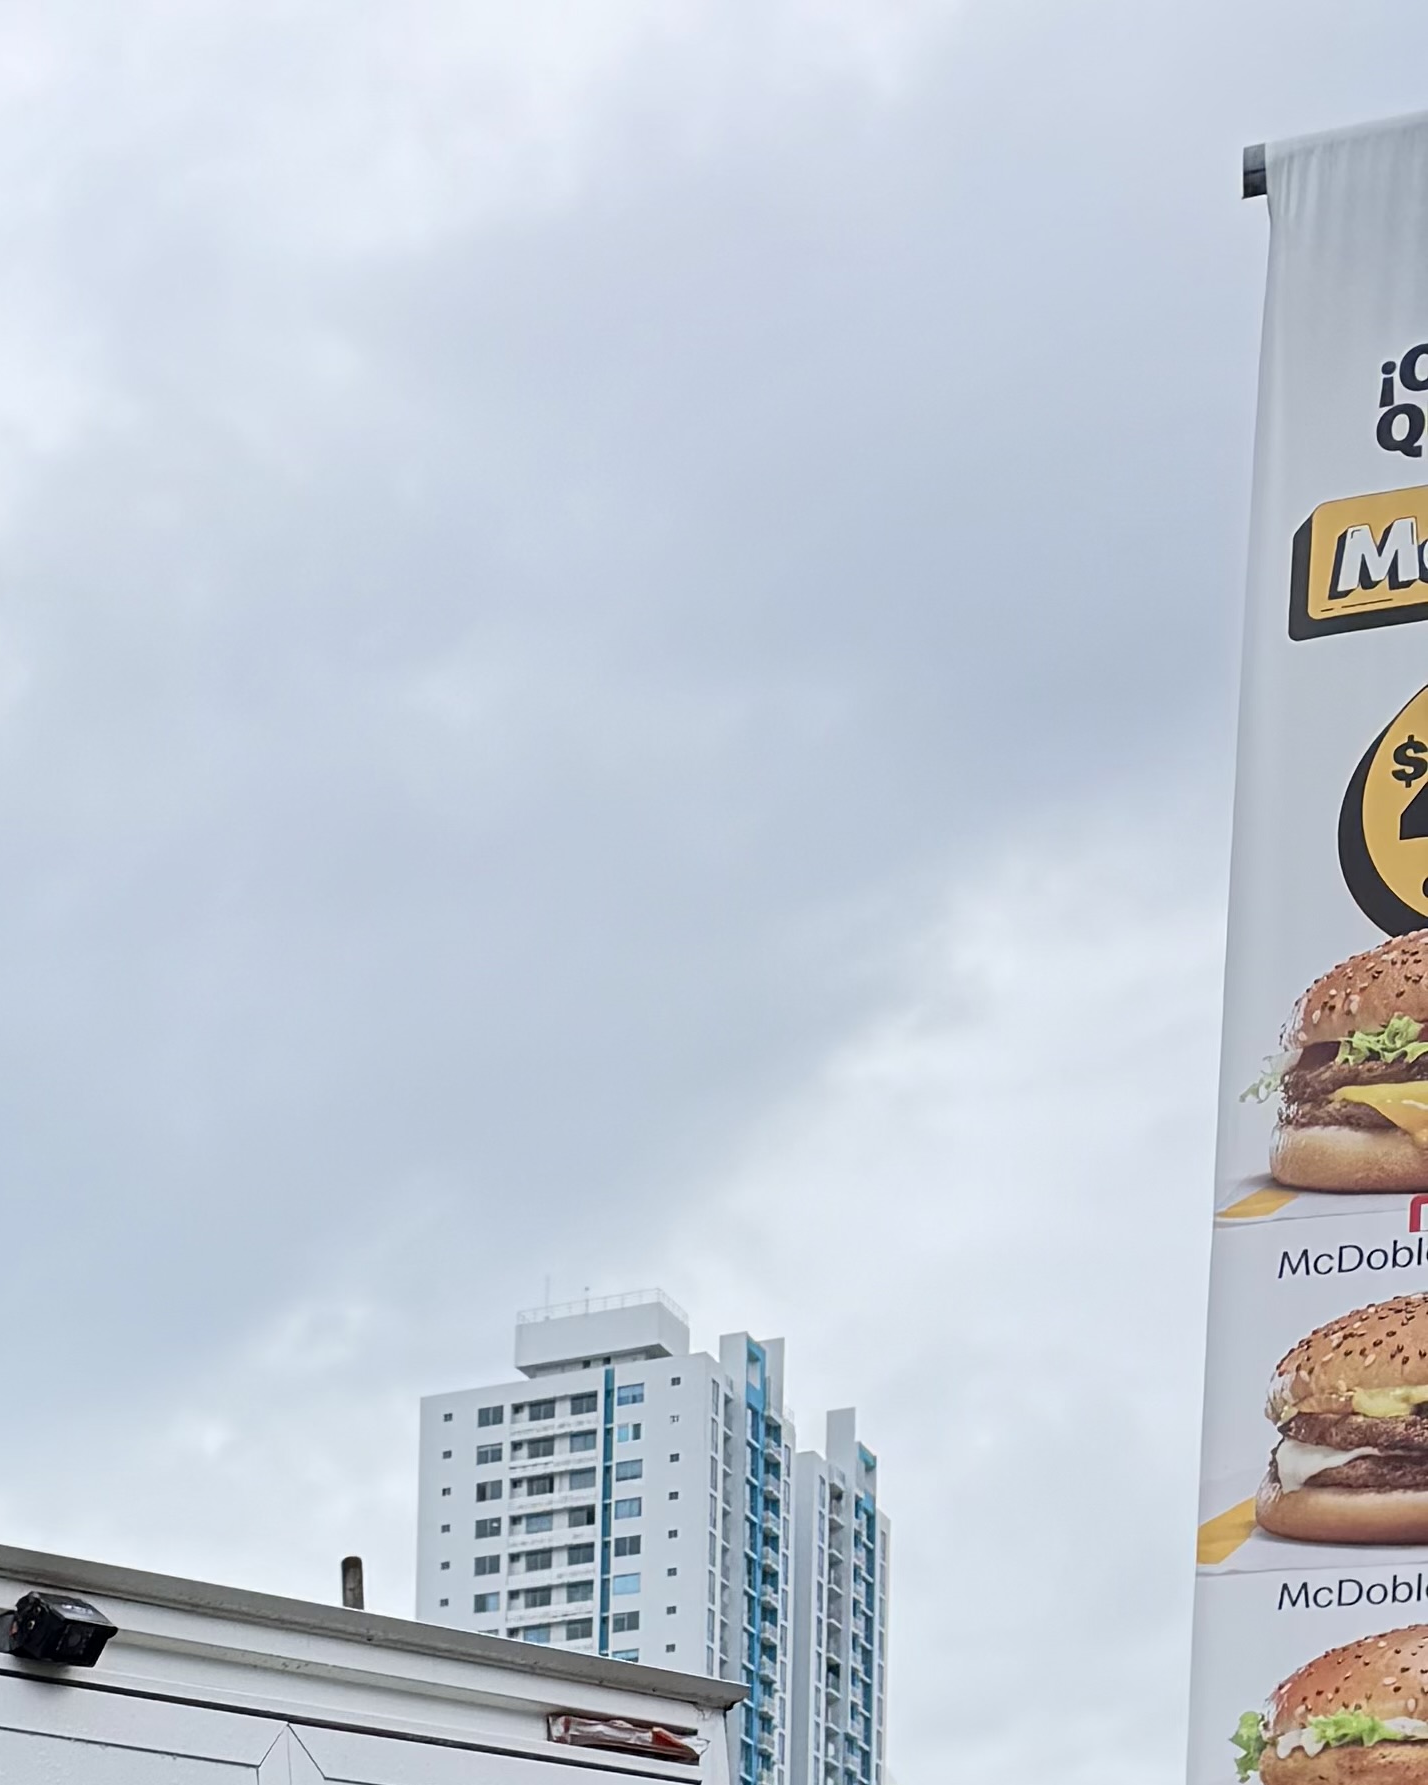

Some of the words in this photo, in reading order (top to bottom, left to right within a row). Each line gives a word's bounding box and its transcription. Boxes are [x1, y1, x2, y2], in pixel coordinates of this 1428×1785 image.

[1327, 516, 1428, 601] M
[1277, 1237, 1428, 1279] McDobl
[1277, 1573, 1428, 1611] McDobl
